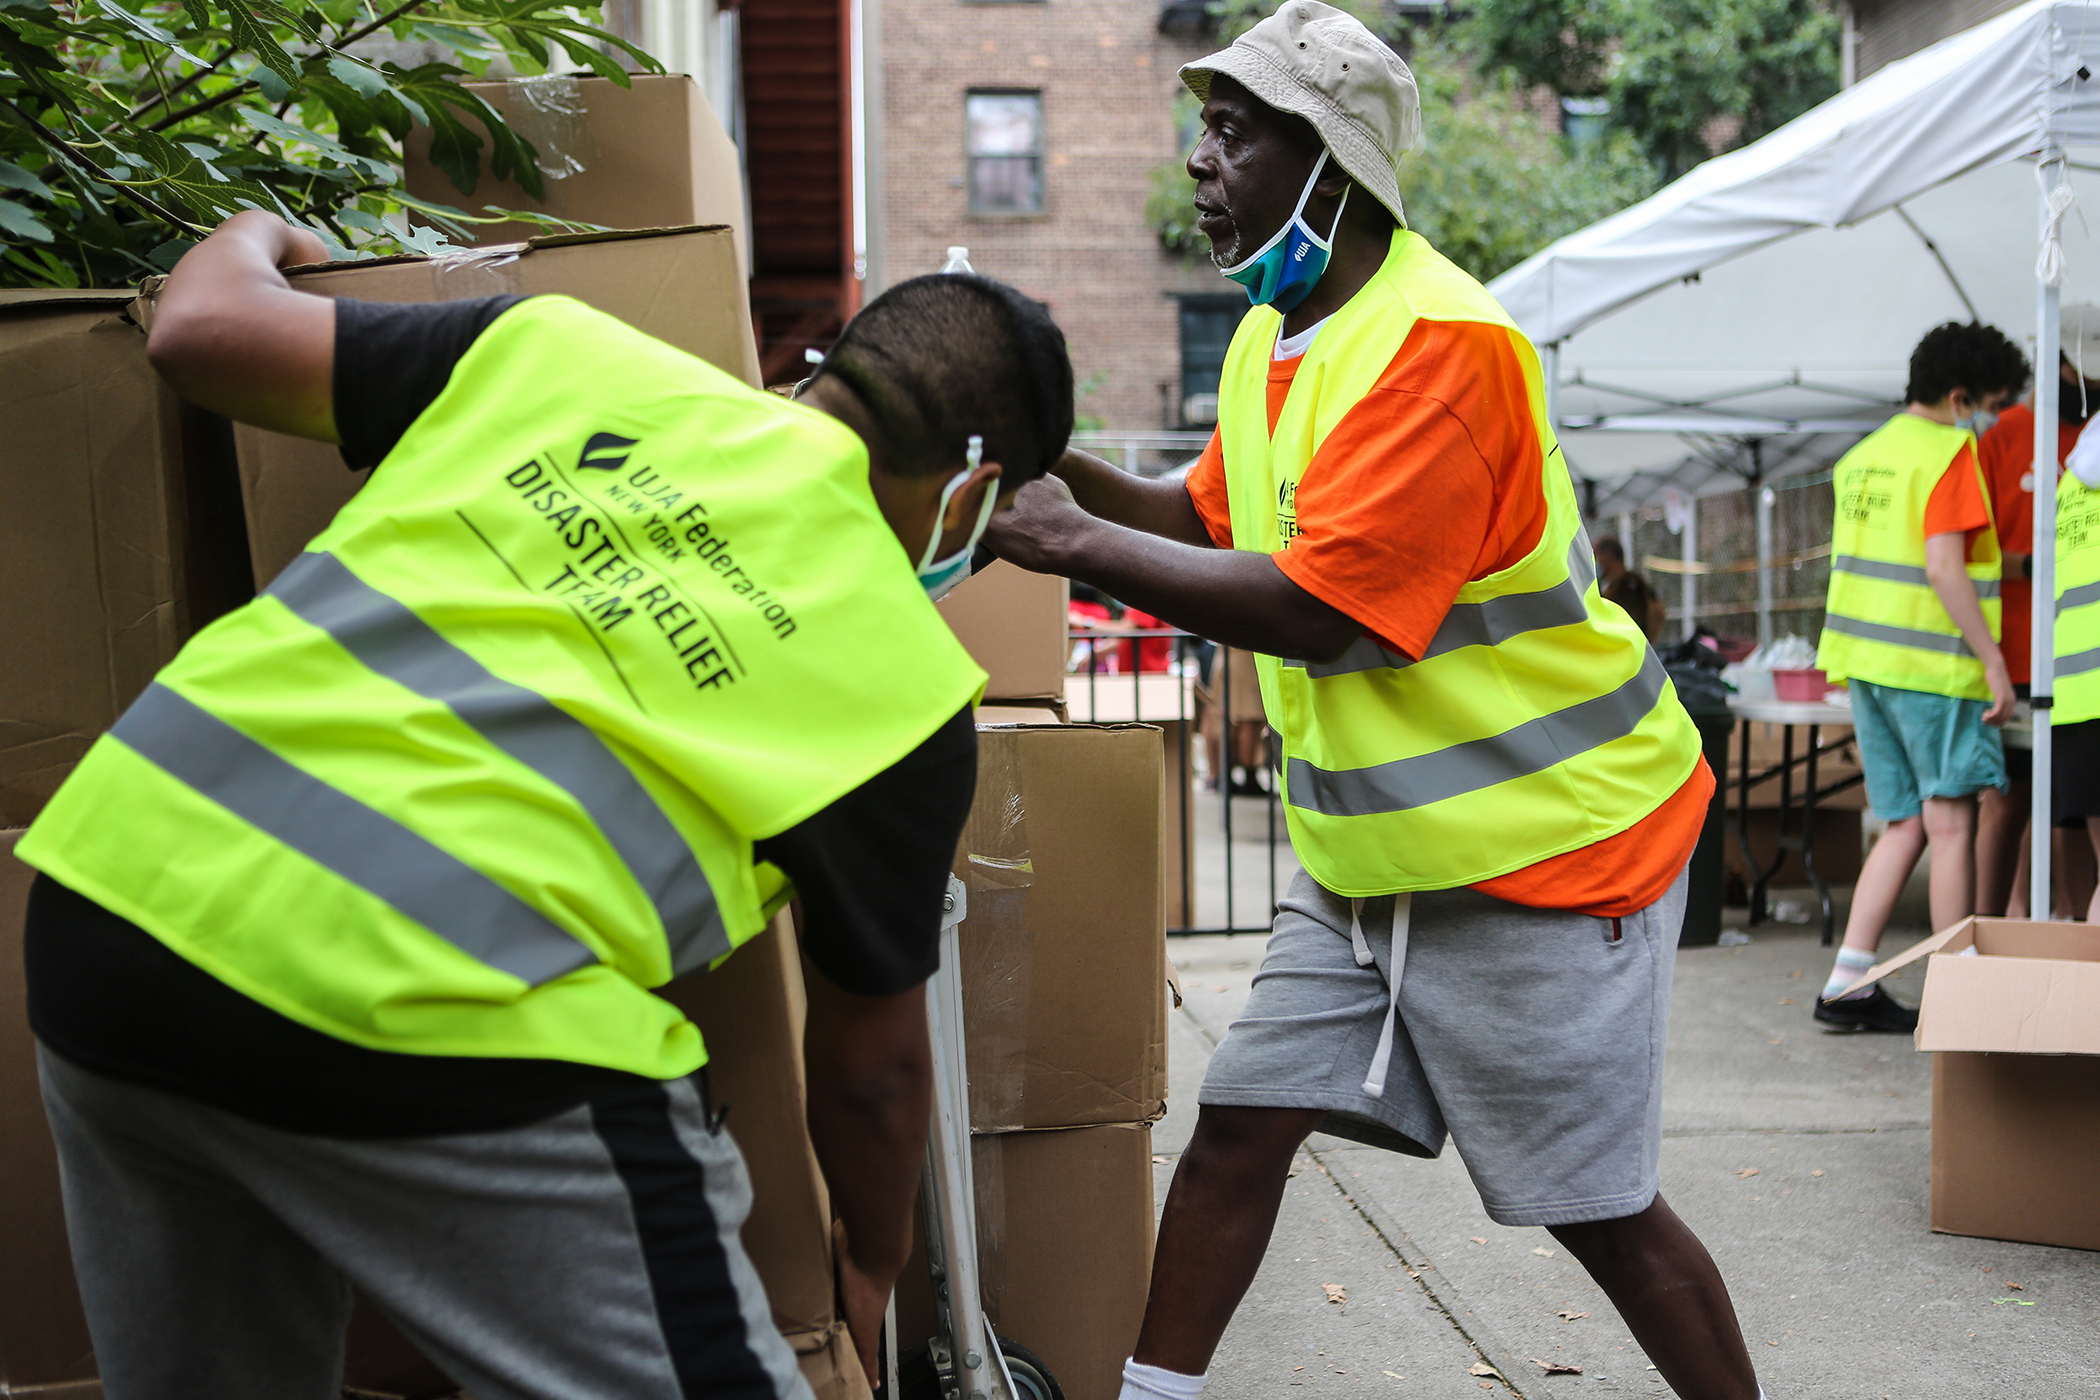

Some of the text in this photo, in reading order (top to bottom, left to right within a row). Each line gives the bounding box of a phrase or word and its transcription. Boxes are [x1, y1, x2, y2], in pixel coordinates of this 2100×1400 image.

[1296, 241, 1311, 258] UJA
[604, 484, 687, 564] NEW YORK
[628, 465, 798, 641] UJA Federation
[504, 459, 736, 692] DISASTER RELIEF
[543, 563, 635, 632] TEAM
